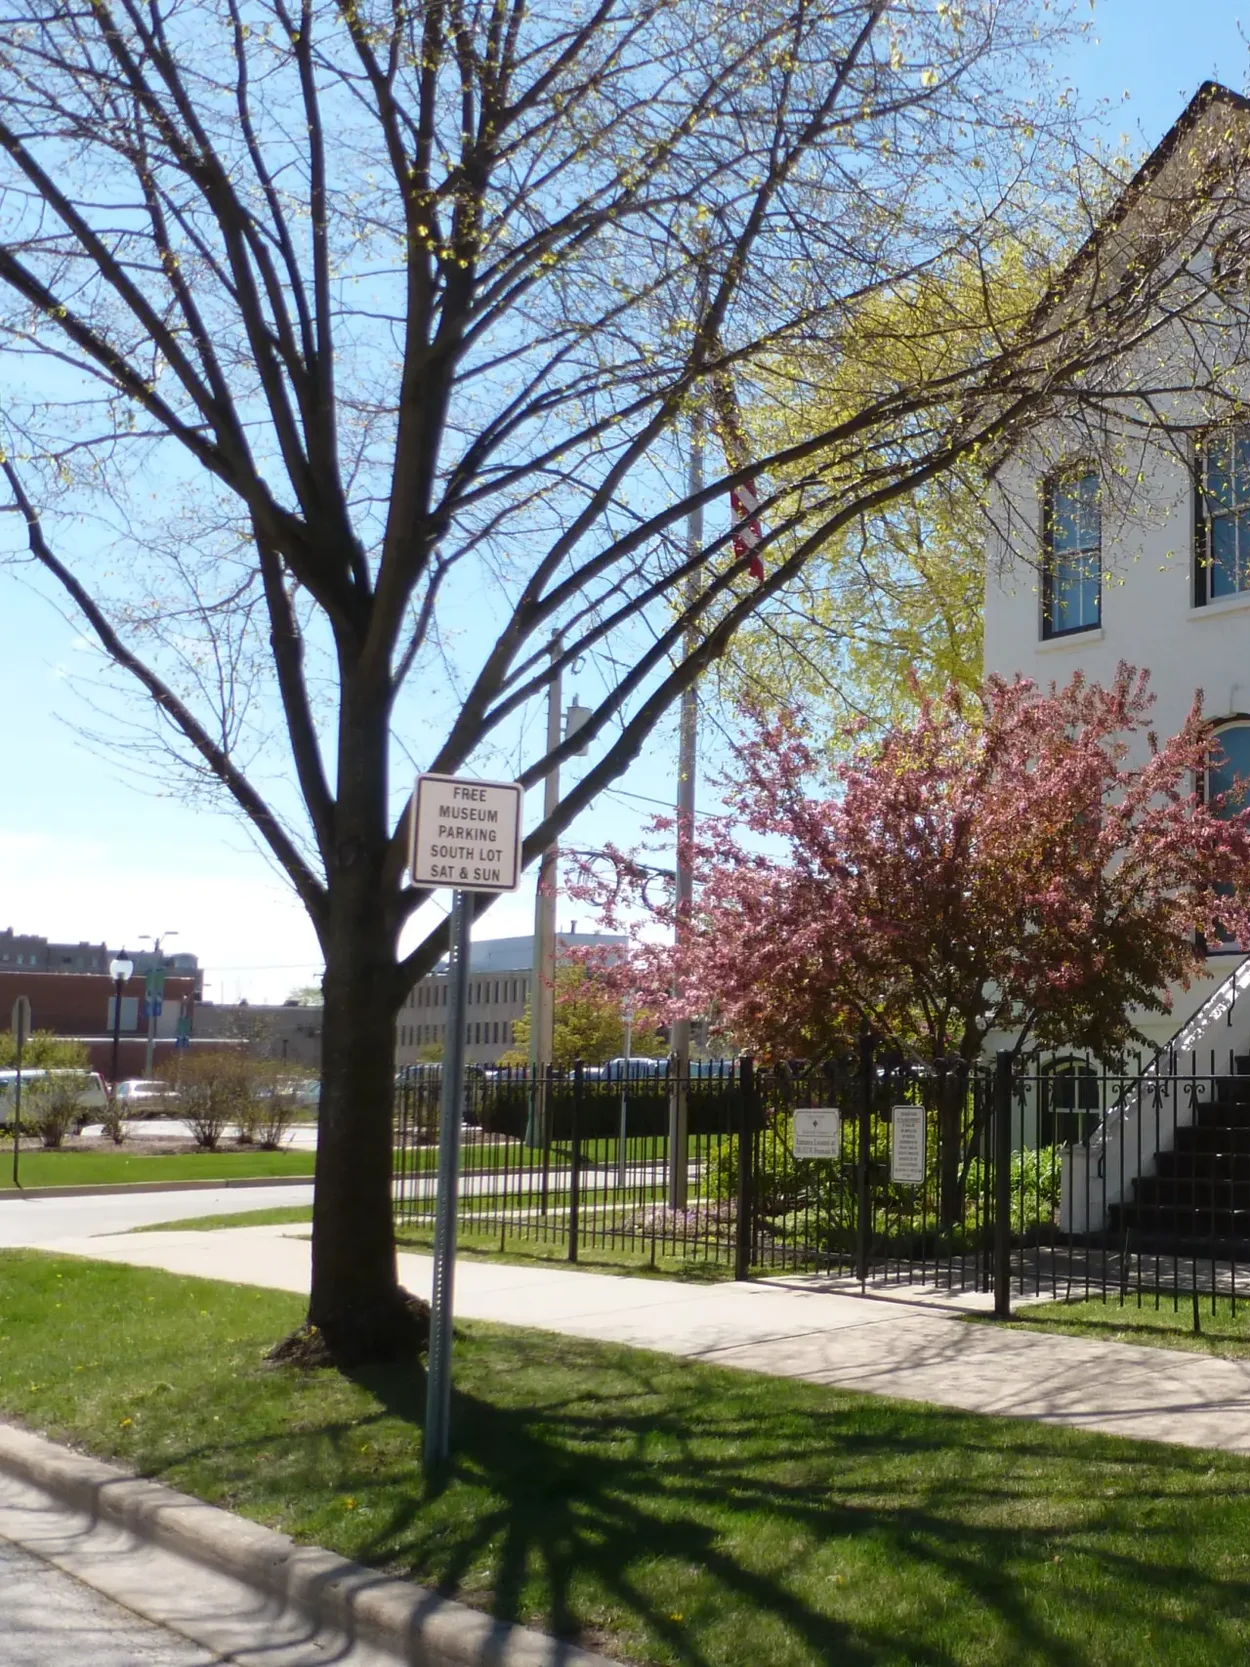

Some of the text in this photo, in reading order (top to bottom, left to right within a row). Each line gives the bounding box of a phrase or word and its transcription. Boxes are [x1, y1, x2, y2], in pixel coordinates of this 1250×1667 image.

[453, 786, 488, 803] FREE
[439, 805, 498, 823] MUSEUM
[438, 825, 498, 842] PARKING
[430, 844, 503, 863] SOUTH LOT
[430, 864, 501, 882] SAT & SUN
